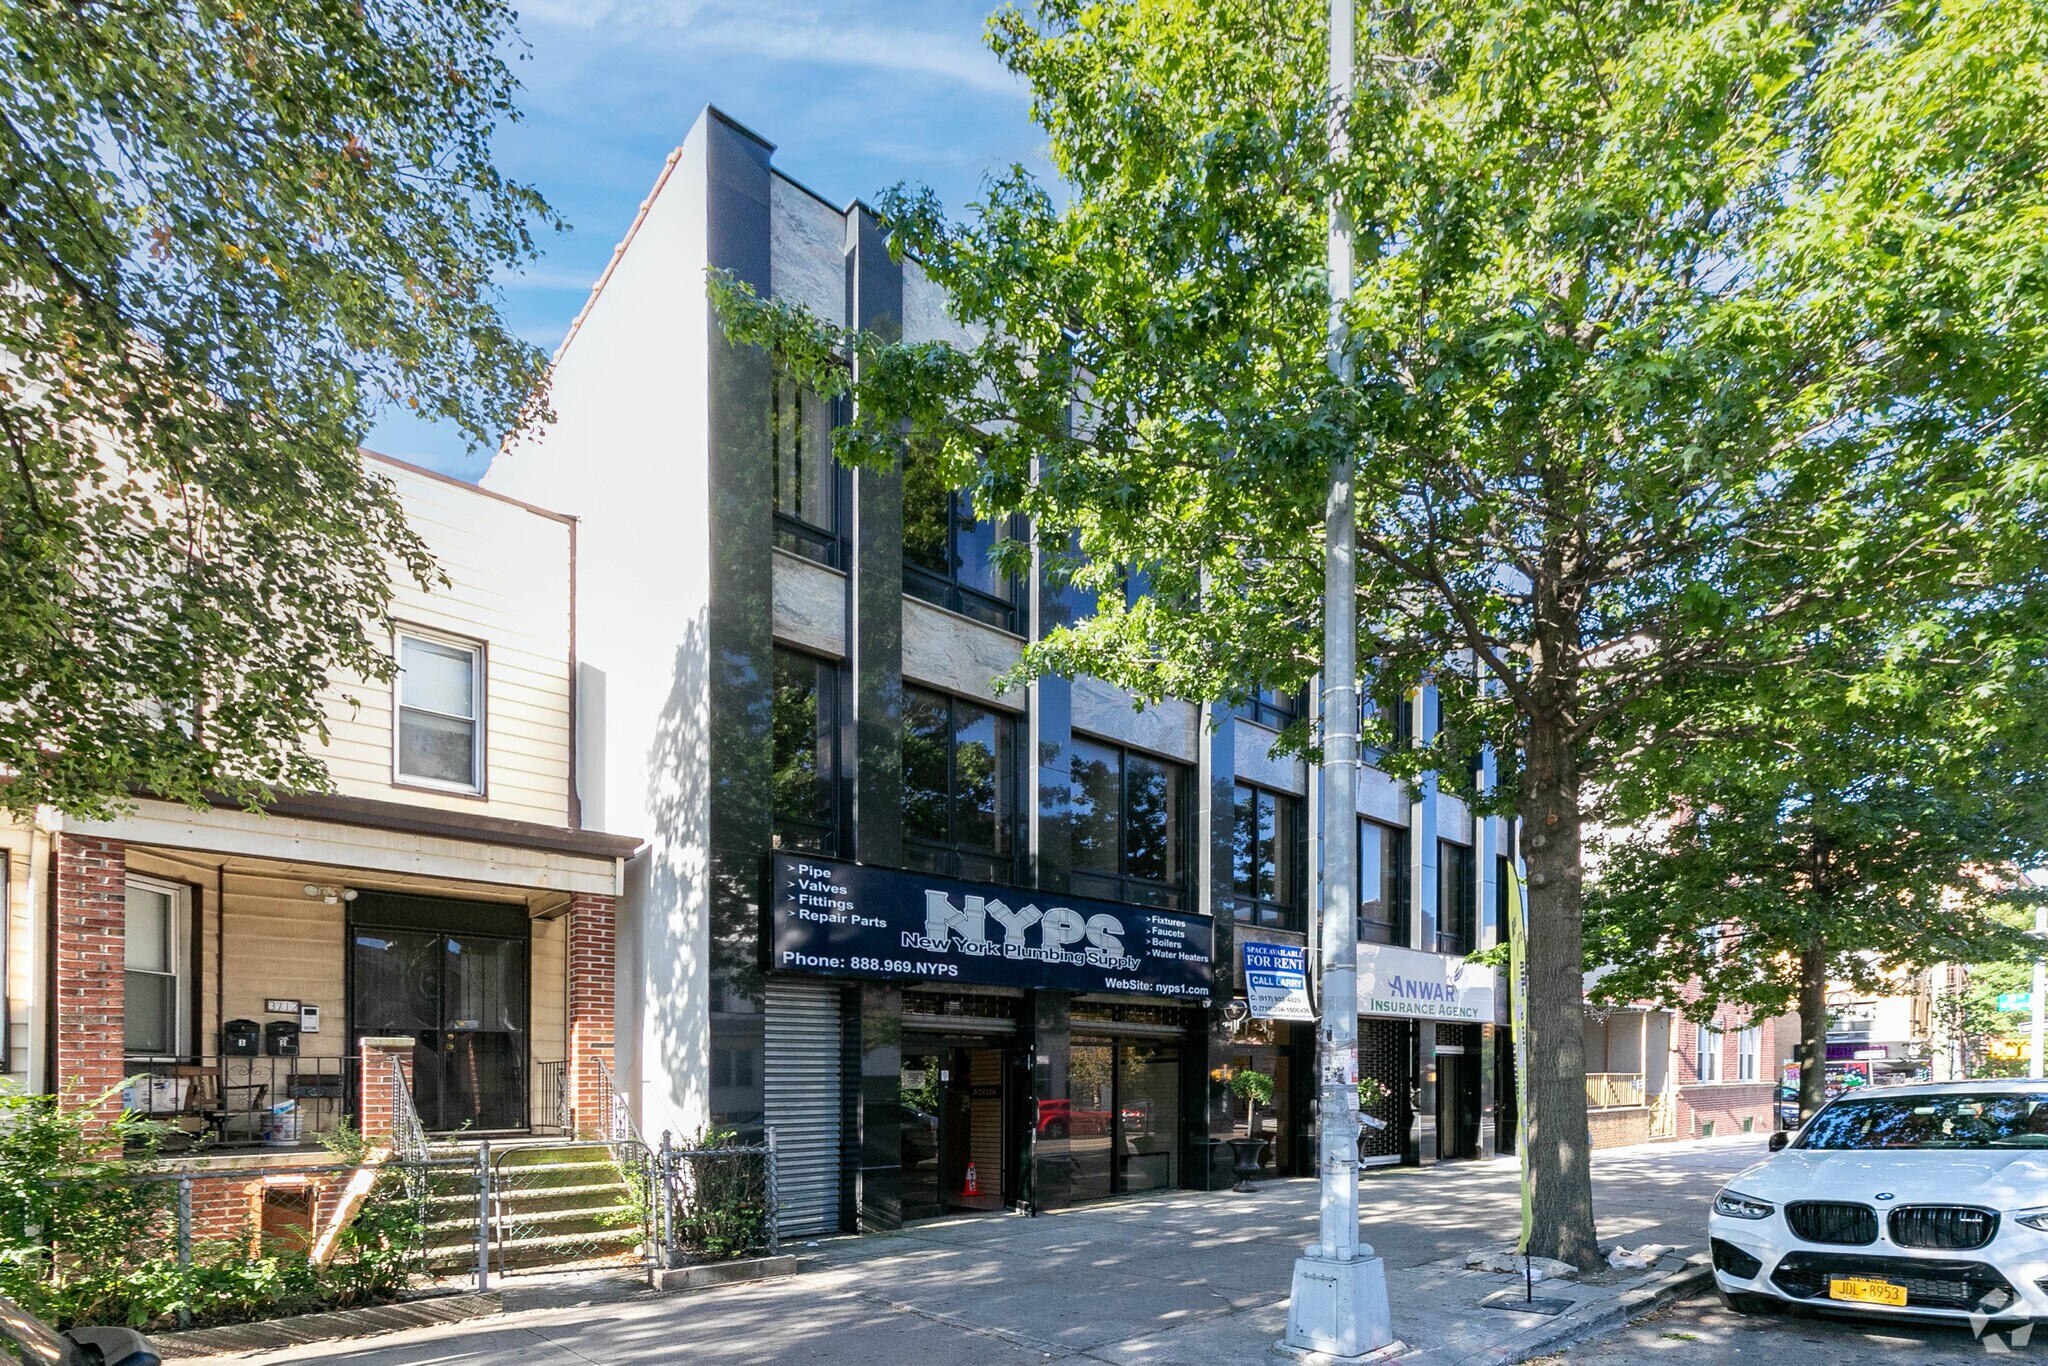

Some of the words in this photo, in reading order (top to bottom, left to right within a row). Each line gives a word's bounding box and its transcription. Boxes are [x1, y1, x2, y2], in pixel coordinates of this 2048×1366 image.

[798, 864, 832, 879] Pipe
[798, 879, 848, 895] Valves
[799, 894, 854, 911] Fittings
[799, 909, 848, 924] Repair
[851, 915, 887, 928] Parts
[1151, 915, 1186, 928] Fixtures
[925, 889, 1125, 967] NYPS
[1151, 926, 1185, 939] Faucets
[1152, 937, 1182, 949] Boilers
[901, 931, 951, 952] New
[952, 936, 1001, 956] York
[1003, 943, 1086, 967] Plumbing
[1086, 952, 1141, 972] Supply
[1151, 948, 1176, 960] Water
[1178, 952, 1209, 963] Heaters
[1247, 946, 1268, 954] SPACE
[1269, 949, 1302, 957] AVAILABLE
[782, 951, 845, 969] Phone:
[850, 956, 958, 977] 888.969.NYPS
[1247, 955, 1271, 967] FOR
[1274, 958, 1303, 970] RENT
[1105, 977, 1153, 992] WebSite:
[1155, 983, 1209, 995] nyps1.com
[1252, 976, 1274, 985] CALL
[1275, 978, 1302, 988] LARRY
[1388, 975, 1456, 1002] ANWAR
[270, 1001, 298, 1011] 3712
[1371, 998, 1435, 1015] INSURANCE
[1438, 1003, 1479, 1018] AGENCY
[978, 1088, 996, 1096] DELTA
[1838, 1282, 1859, 1296] JDL
[1869, 1284, 1899, 1300] 8953
